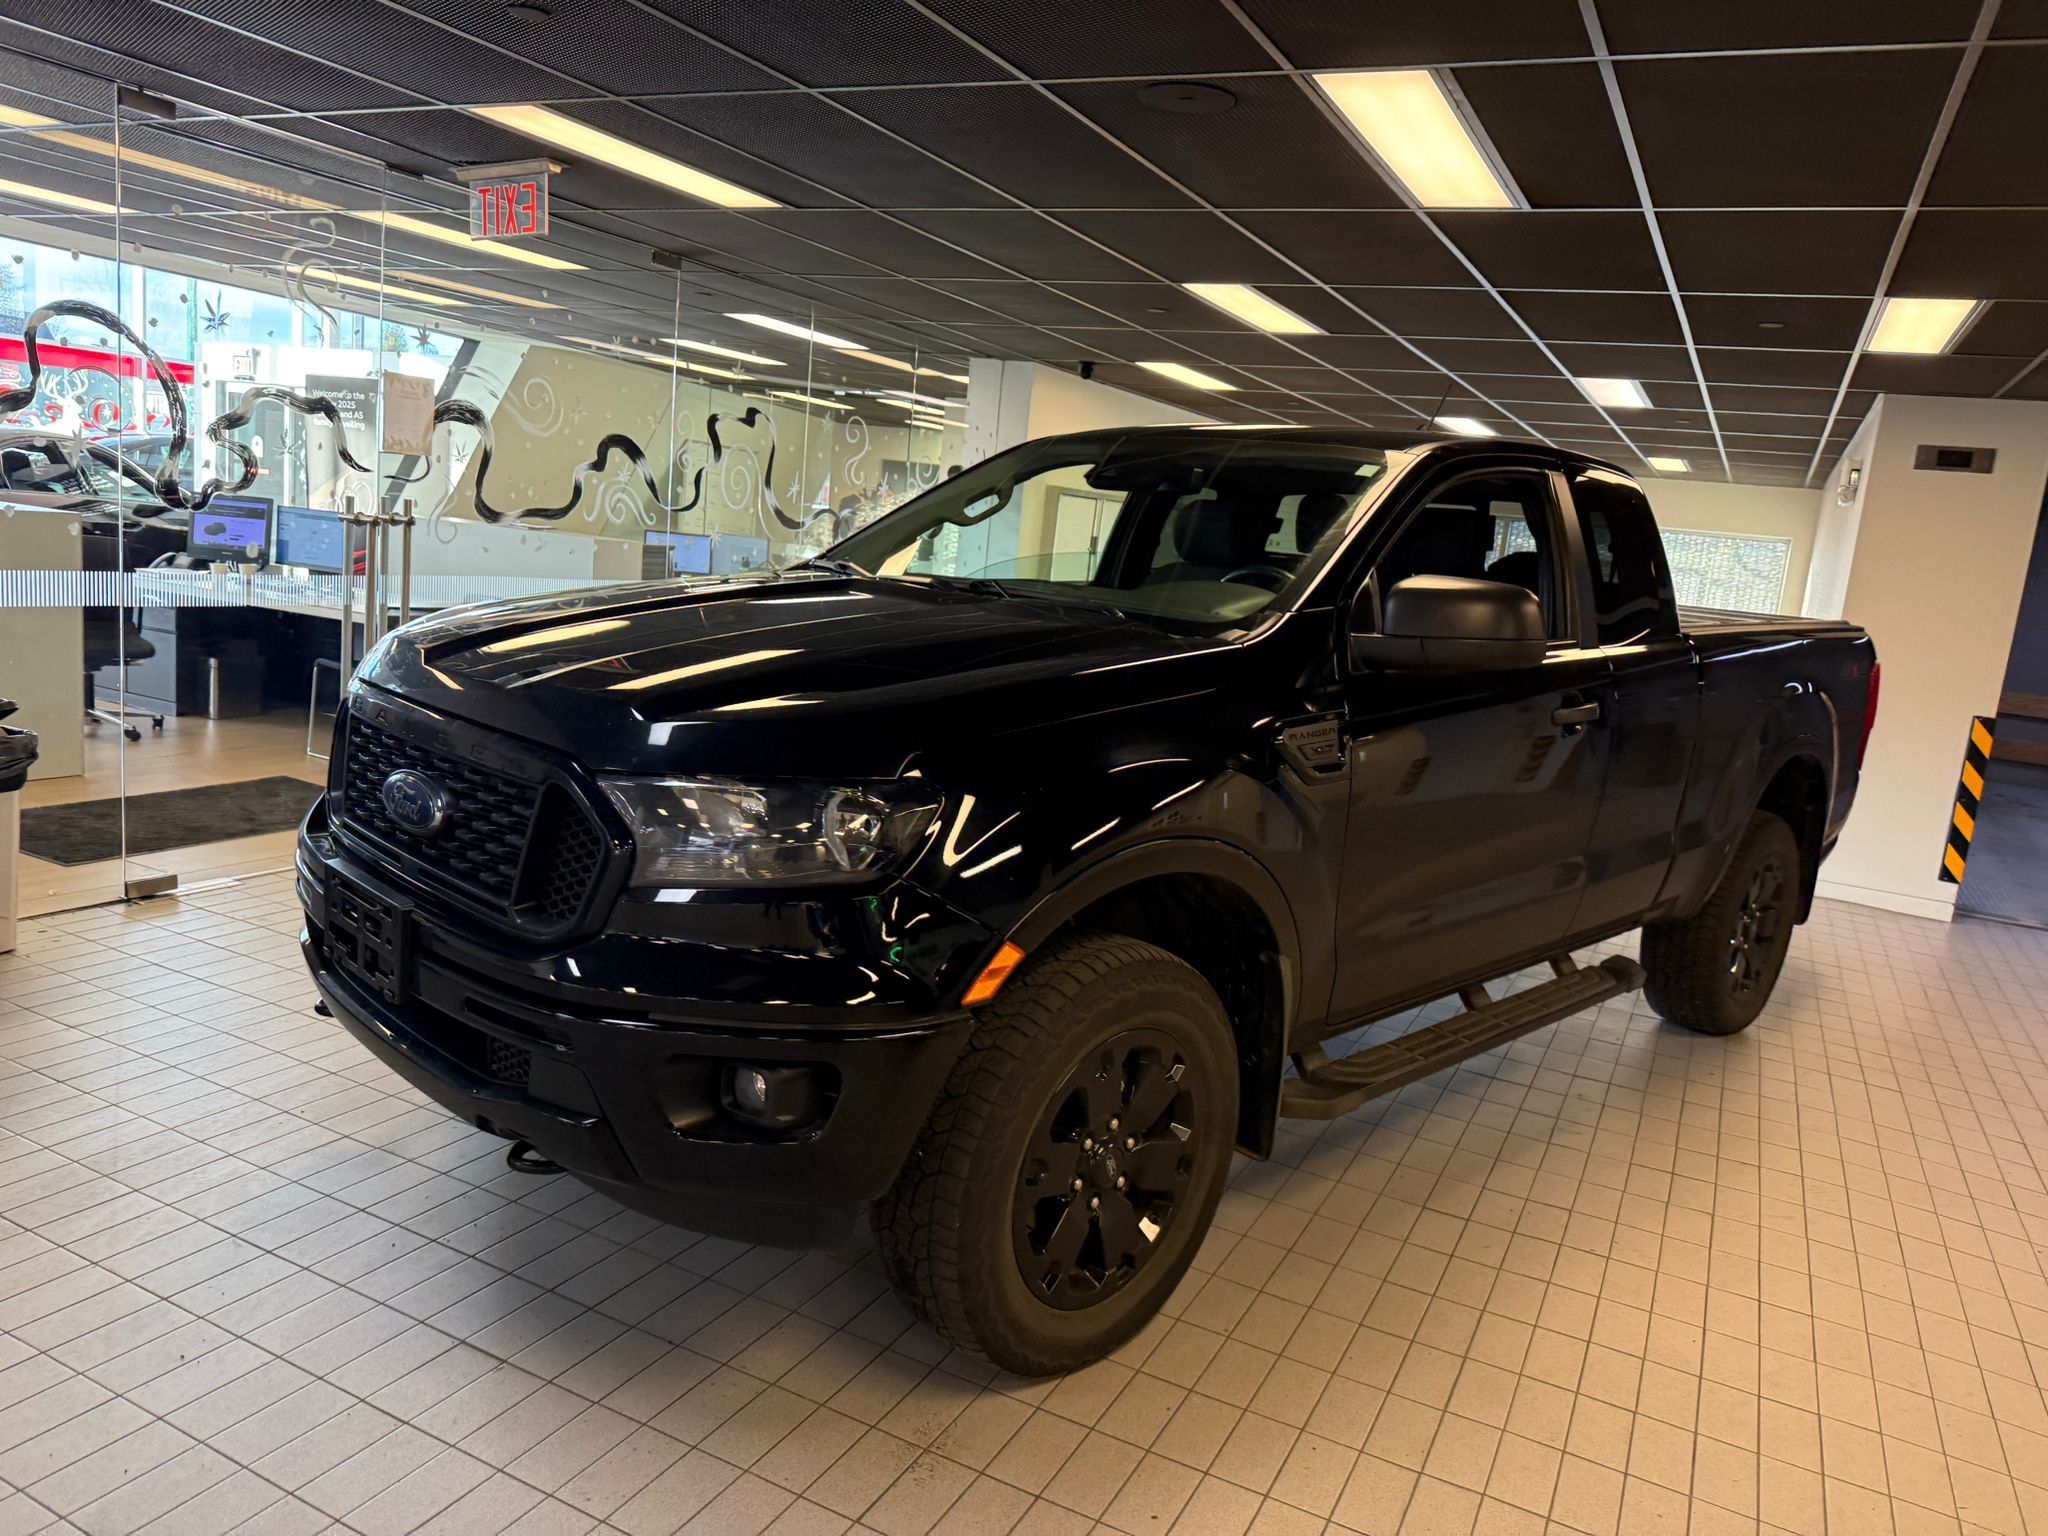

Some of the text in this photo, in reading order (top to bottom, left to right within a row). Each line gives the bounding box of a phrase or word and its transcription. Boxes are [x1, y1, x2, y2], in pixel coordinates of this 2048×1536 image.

[312, 389, 343, 399] Welcome
[353, 392, 365, 400] the
[338, 400, 356, 409] 2025
[340, 411, 352, 419] and
[1289, 727, 1337, 741] RANGER
[389, 781, 422, 821] Ford
